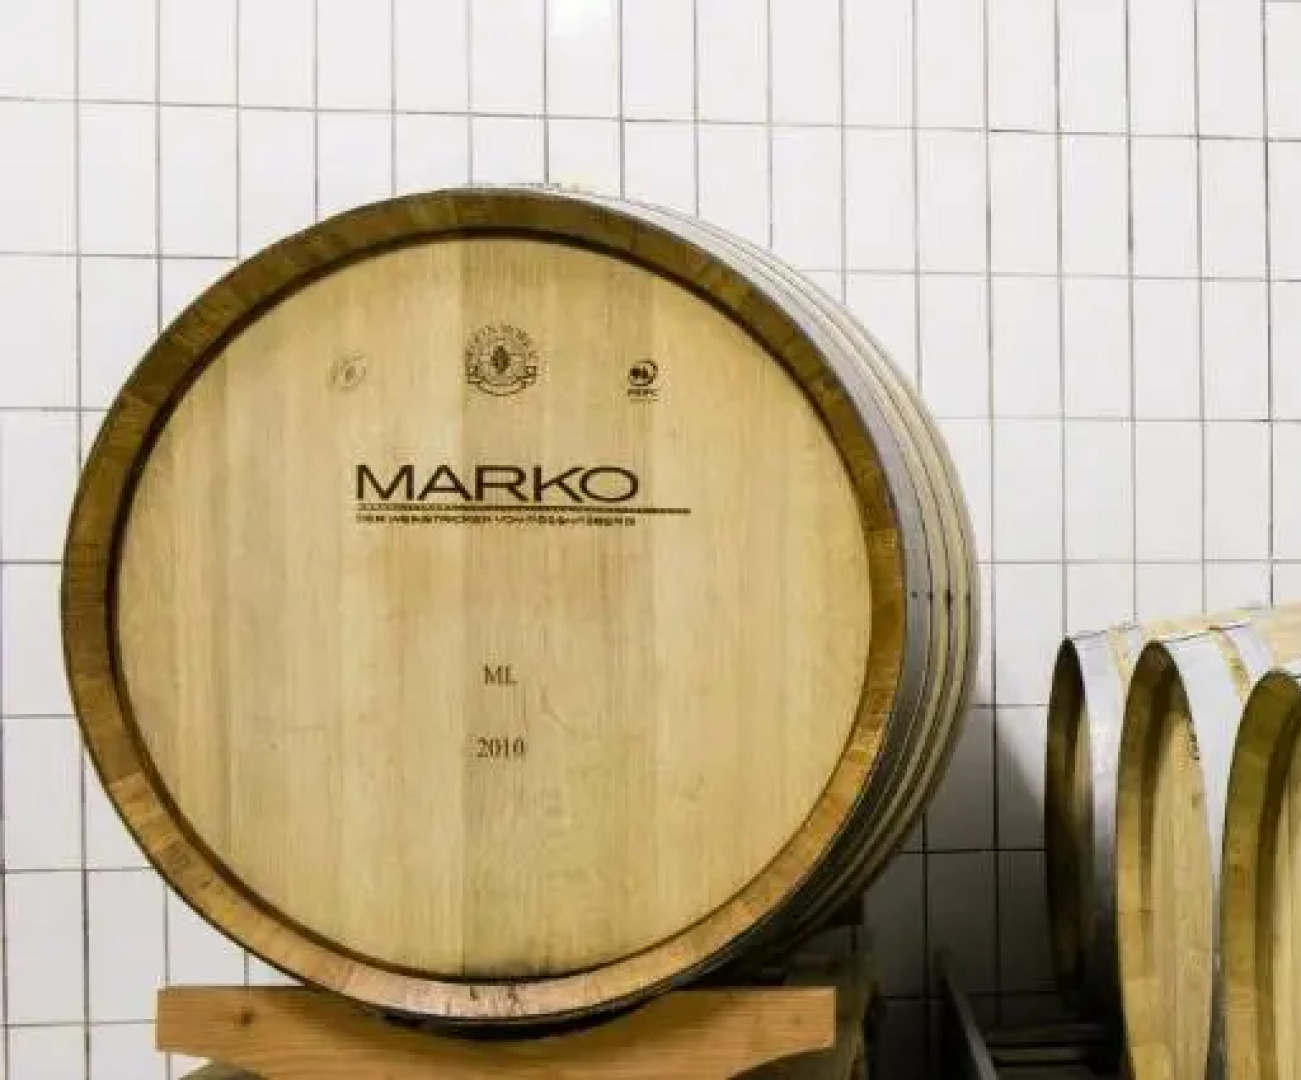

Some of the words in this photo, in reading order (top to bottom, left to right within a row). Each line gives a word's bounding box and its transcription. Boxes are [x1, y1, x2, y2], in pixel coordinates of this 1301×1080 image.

[356, 465, 639, 502] MARKO
[483, 663, 518, 686] ML
[477, 736, 524, 758] 2010
